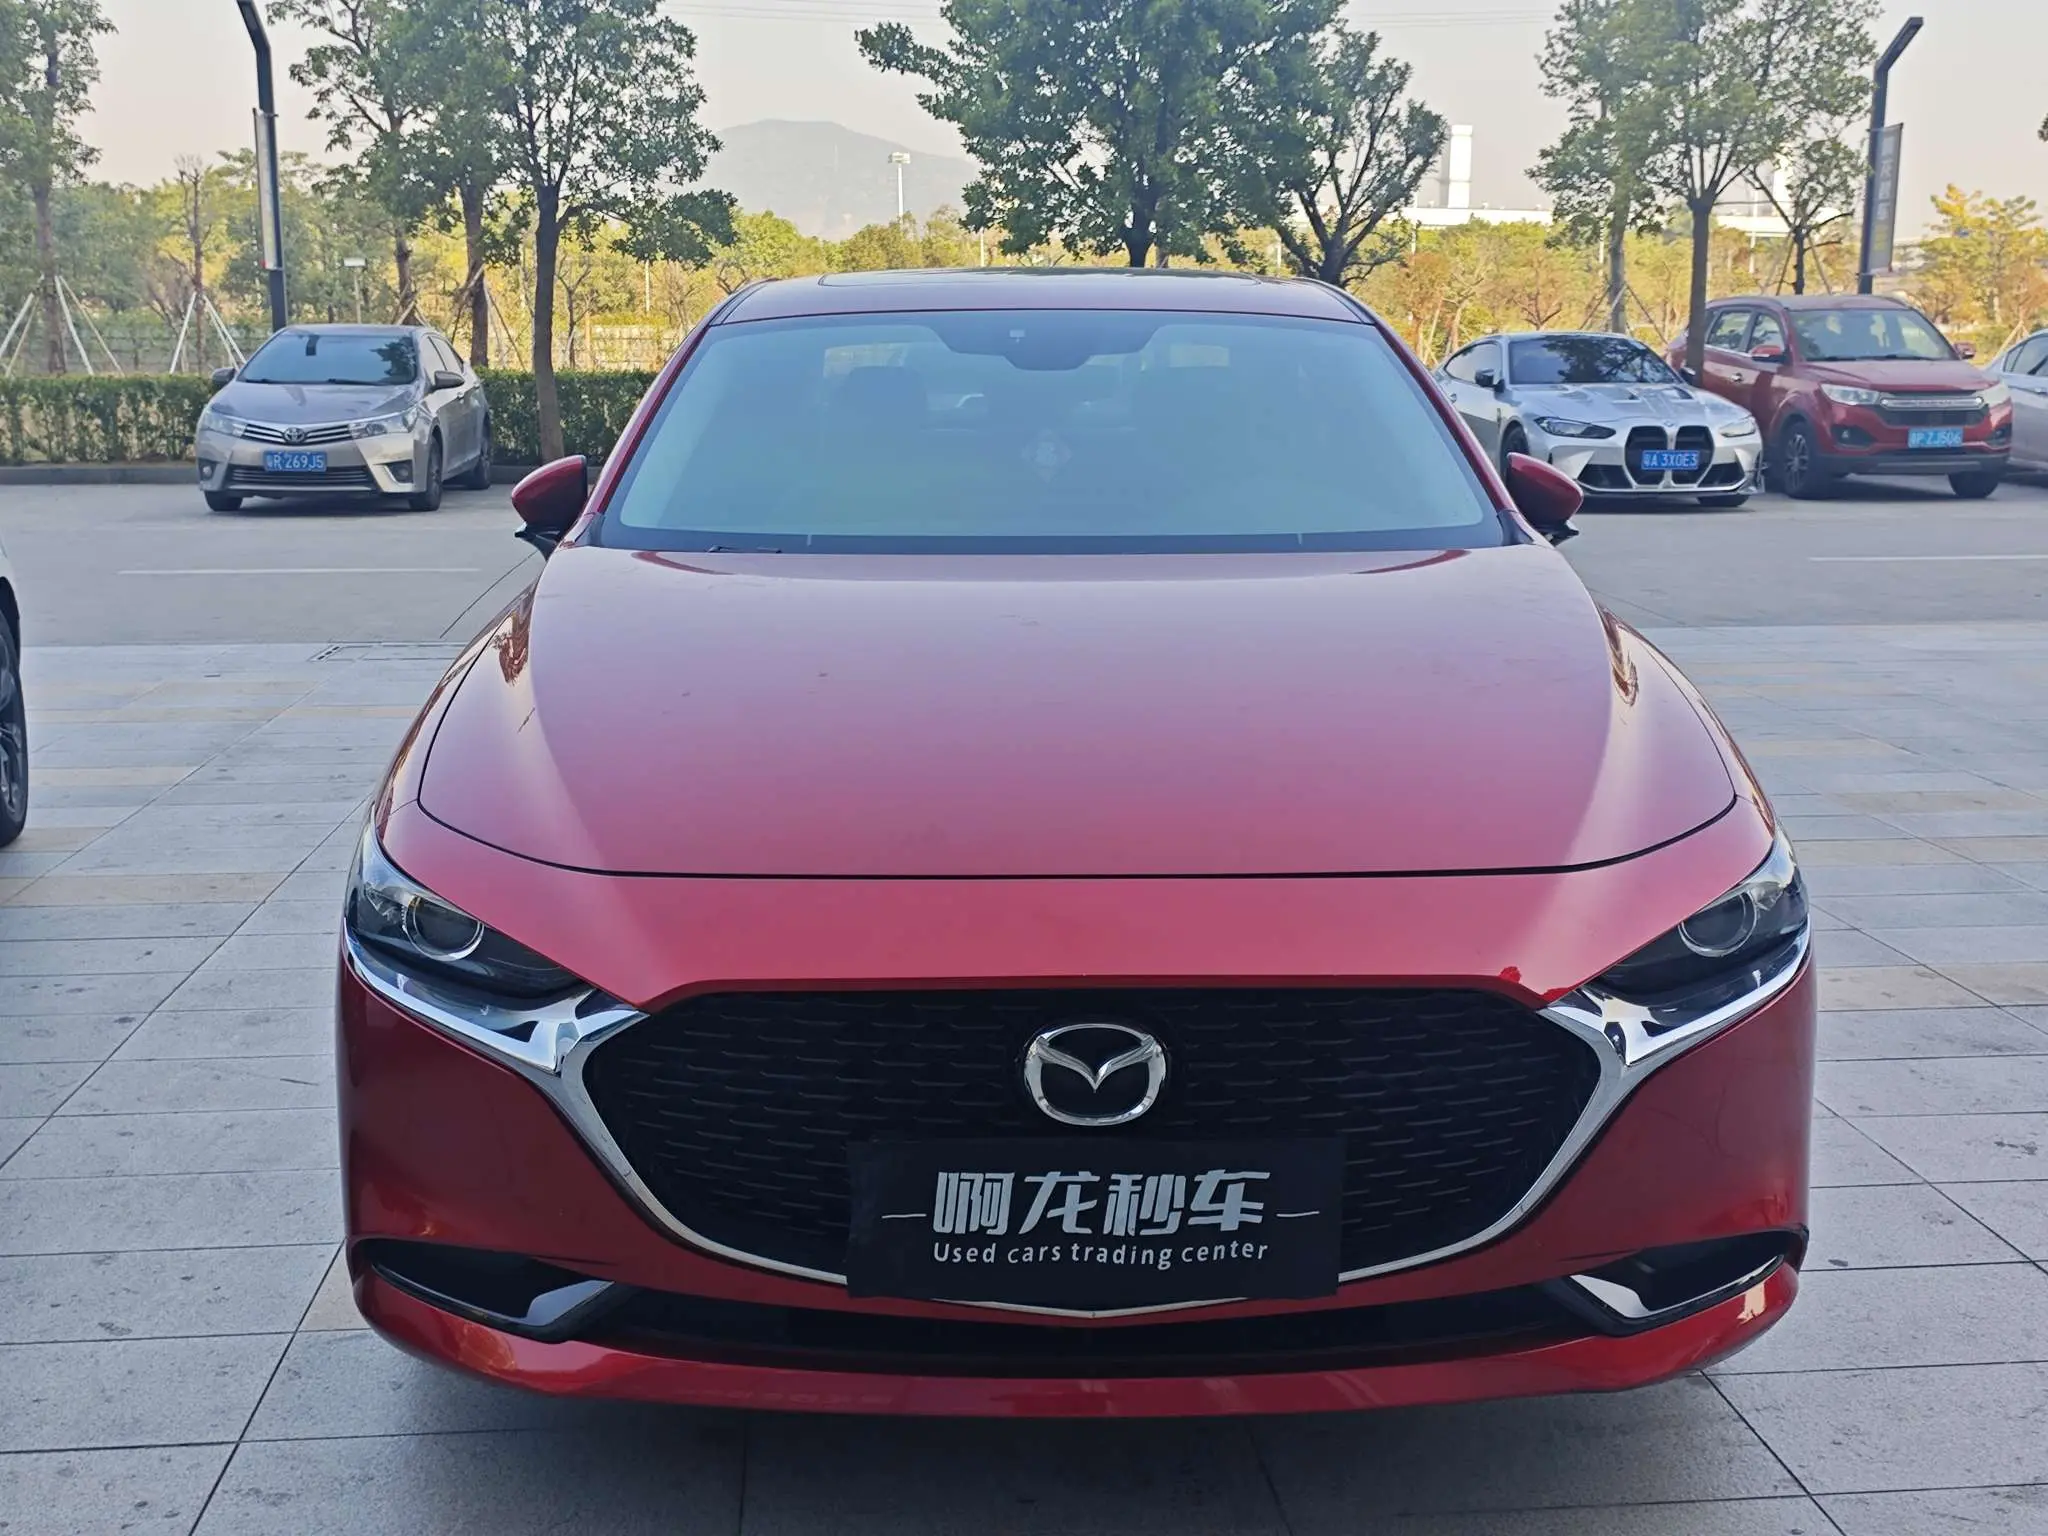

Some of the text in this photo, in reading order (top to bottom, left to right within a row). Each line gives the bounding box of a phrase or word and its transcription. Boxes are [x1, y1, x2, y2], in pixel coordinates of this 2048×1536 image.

[932, 1169, 1271, 1237] 啊龙秒车
[934, 1240, 1269, 1271] Used cars trading center
